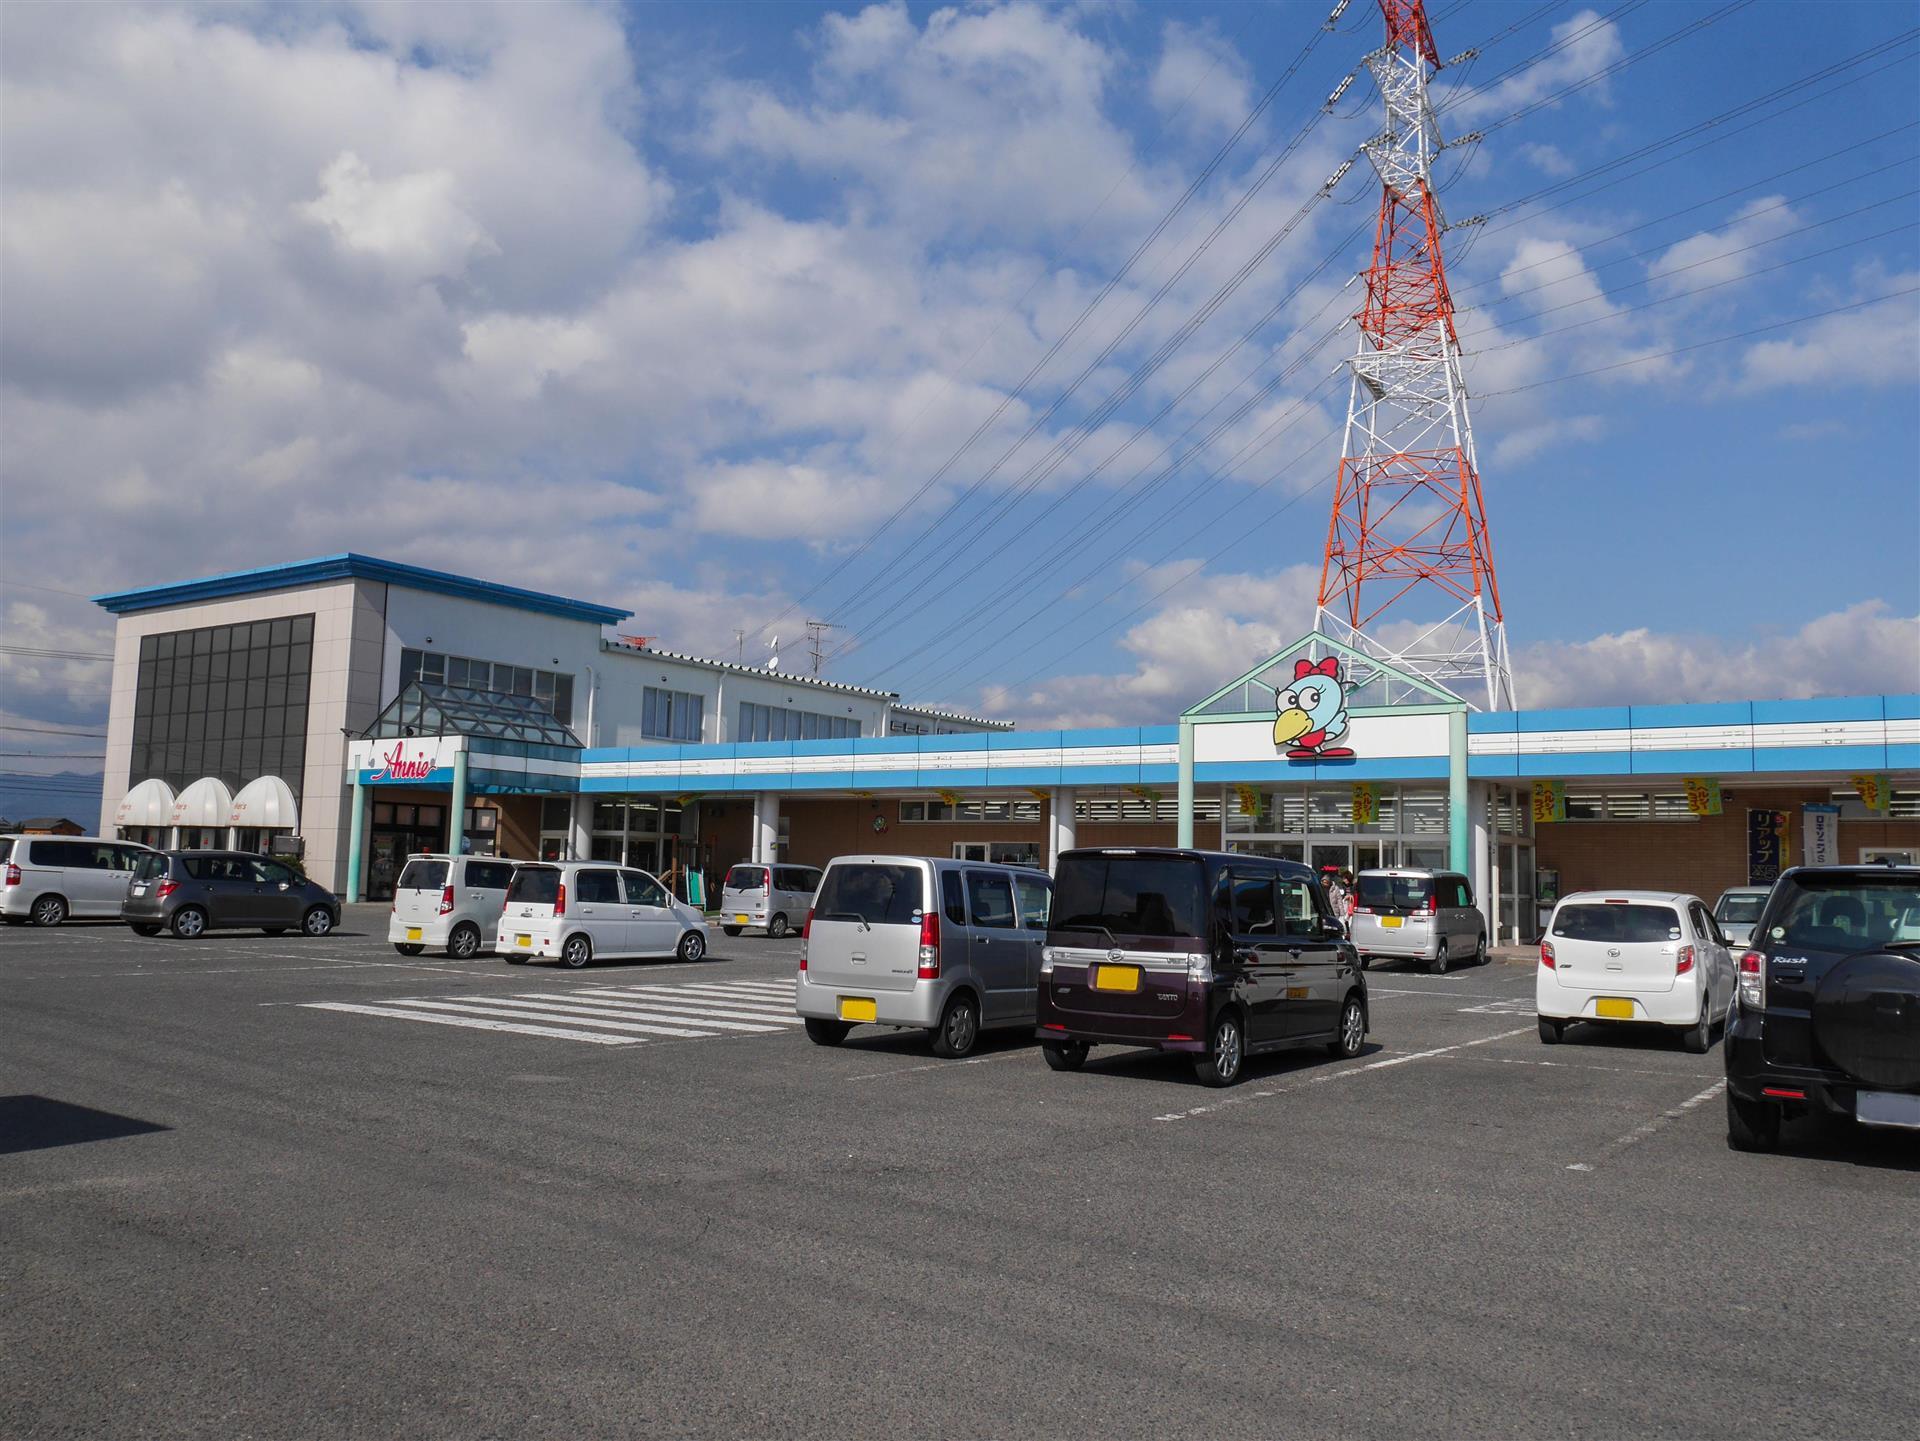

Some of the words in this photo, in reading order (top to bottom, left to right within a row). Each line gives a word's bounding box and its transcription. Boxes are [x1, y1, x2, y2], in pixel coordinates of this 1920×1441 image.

[371, 741, 437, 780] Annie
[1756, 813, 1773, 864] リアップ
[1816, 815, 1825, 863] ロキソニンS
[1772, 956, 1808, 964] Rush
